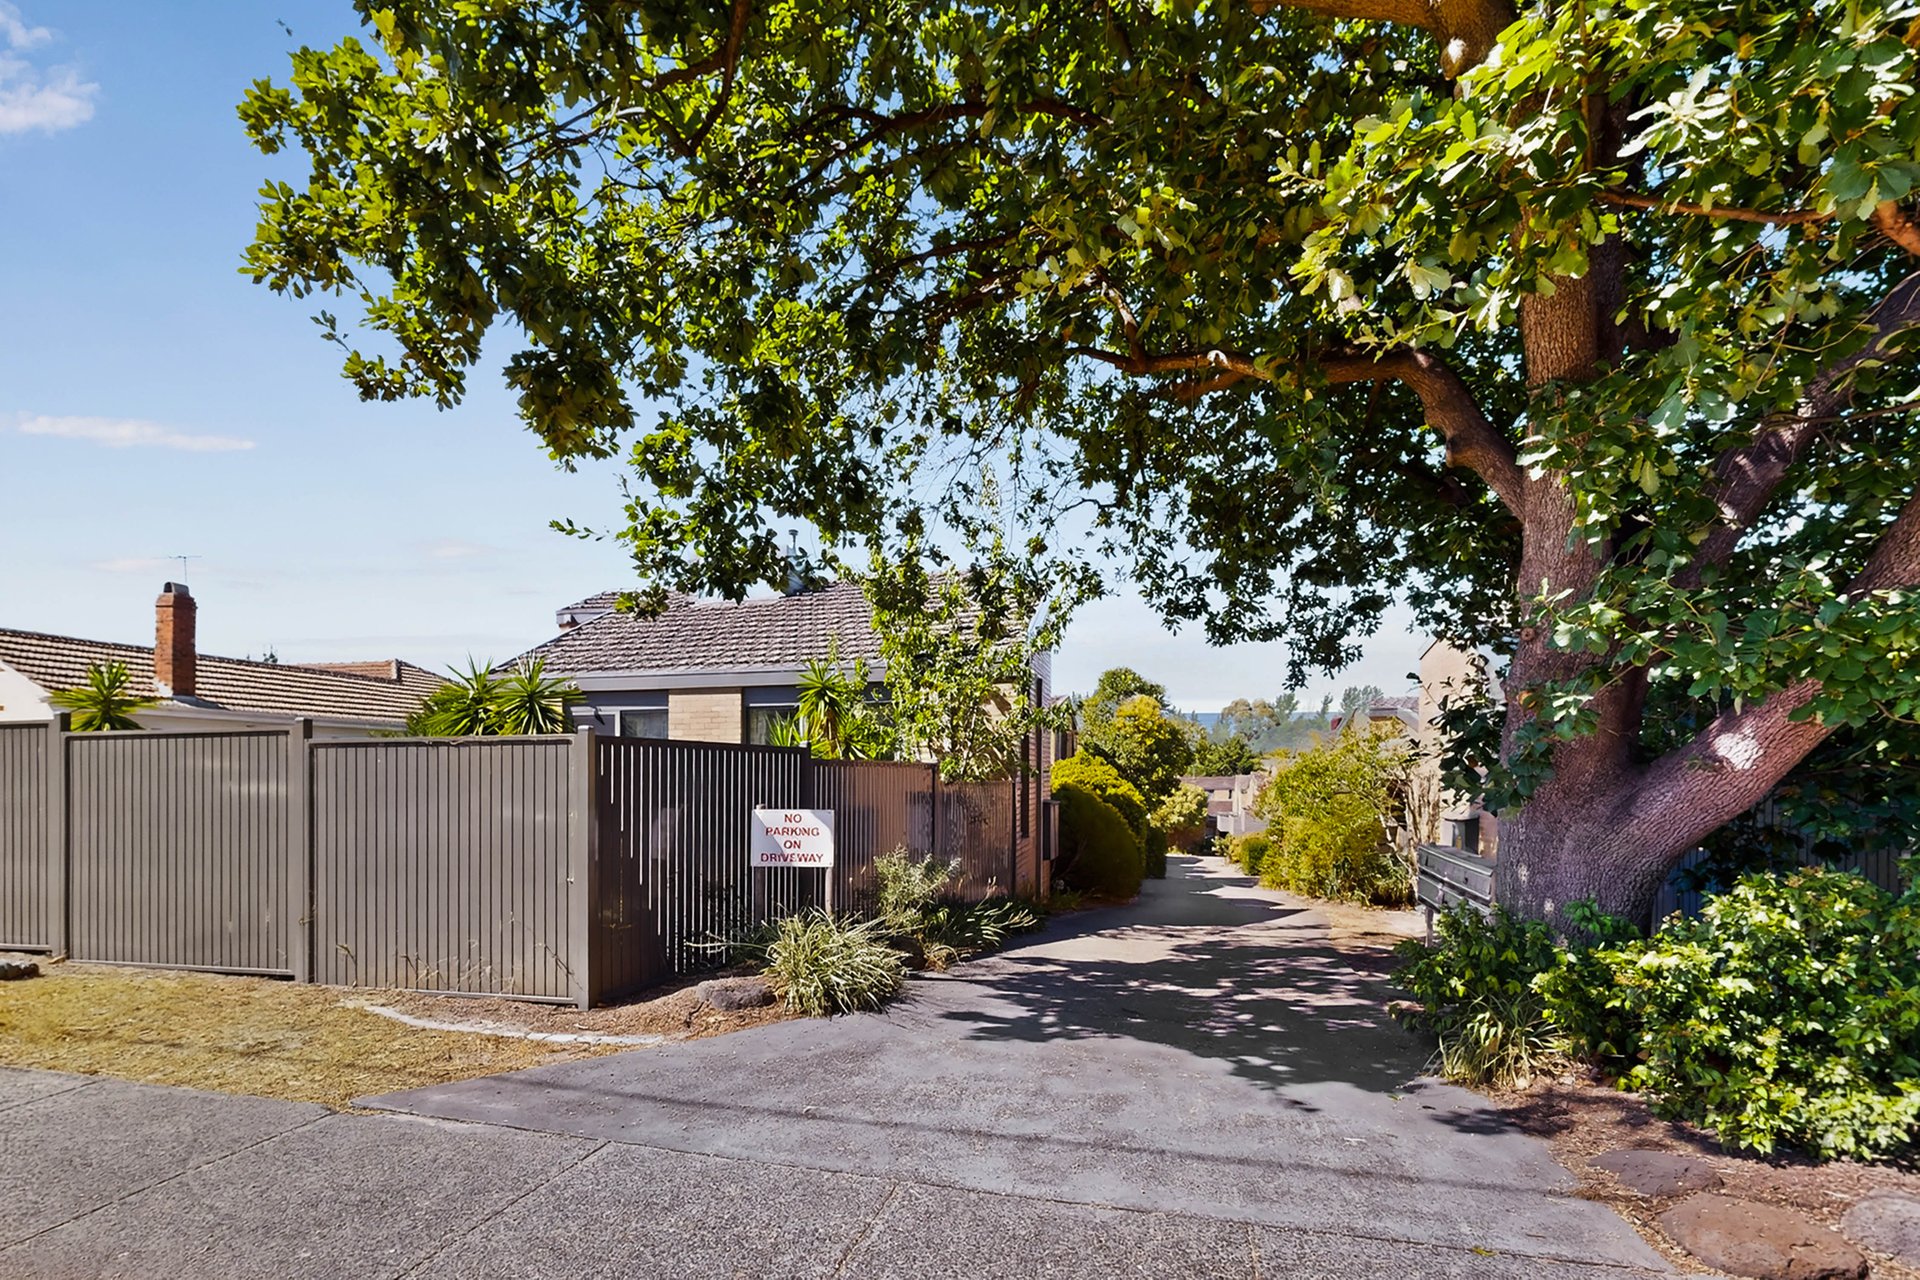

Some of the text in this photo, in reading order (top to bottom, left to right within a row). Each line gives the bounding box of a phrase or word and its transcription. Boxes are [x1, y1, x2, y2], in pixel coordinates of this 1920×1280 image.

[784, 814, 802, 823] NO
[765, 827, 820, 836] PARKING
[783, 840, 801, 849] ON
[760, 853, 824, 862] DRIVEWAY
